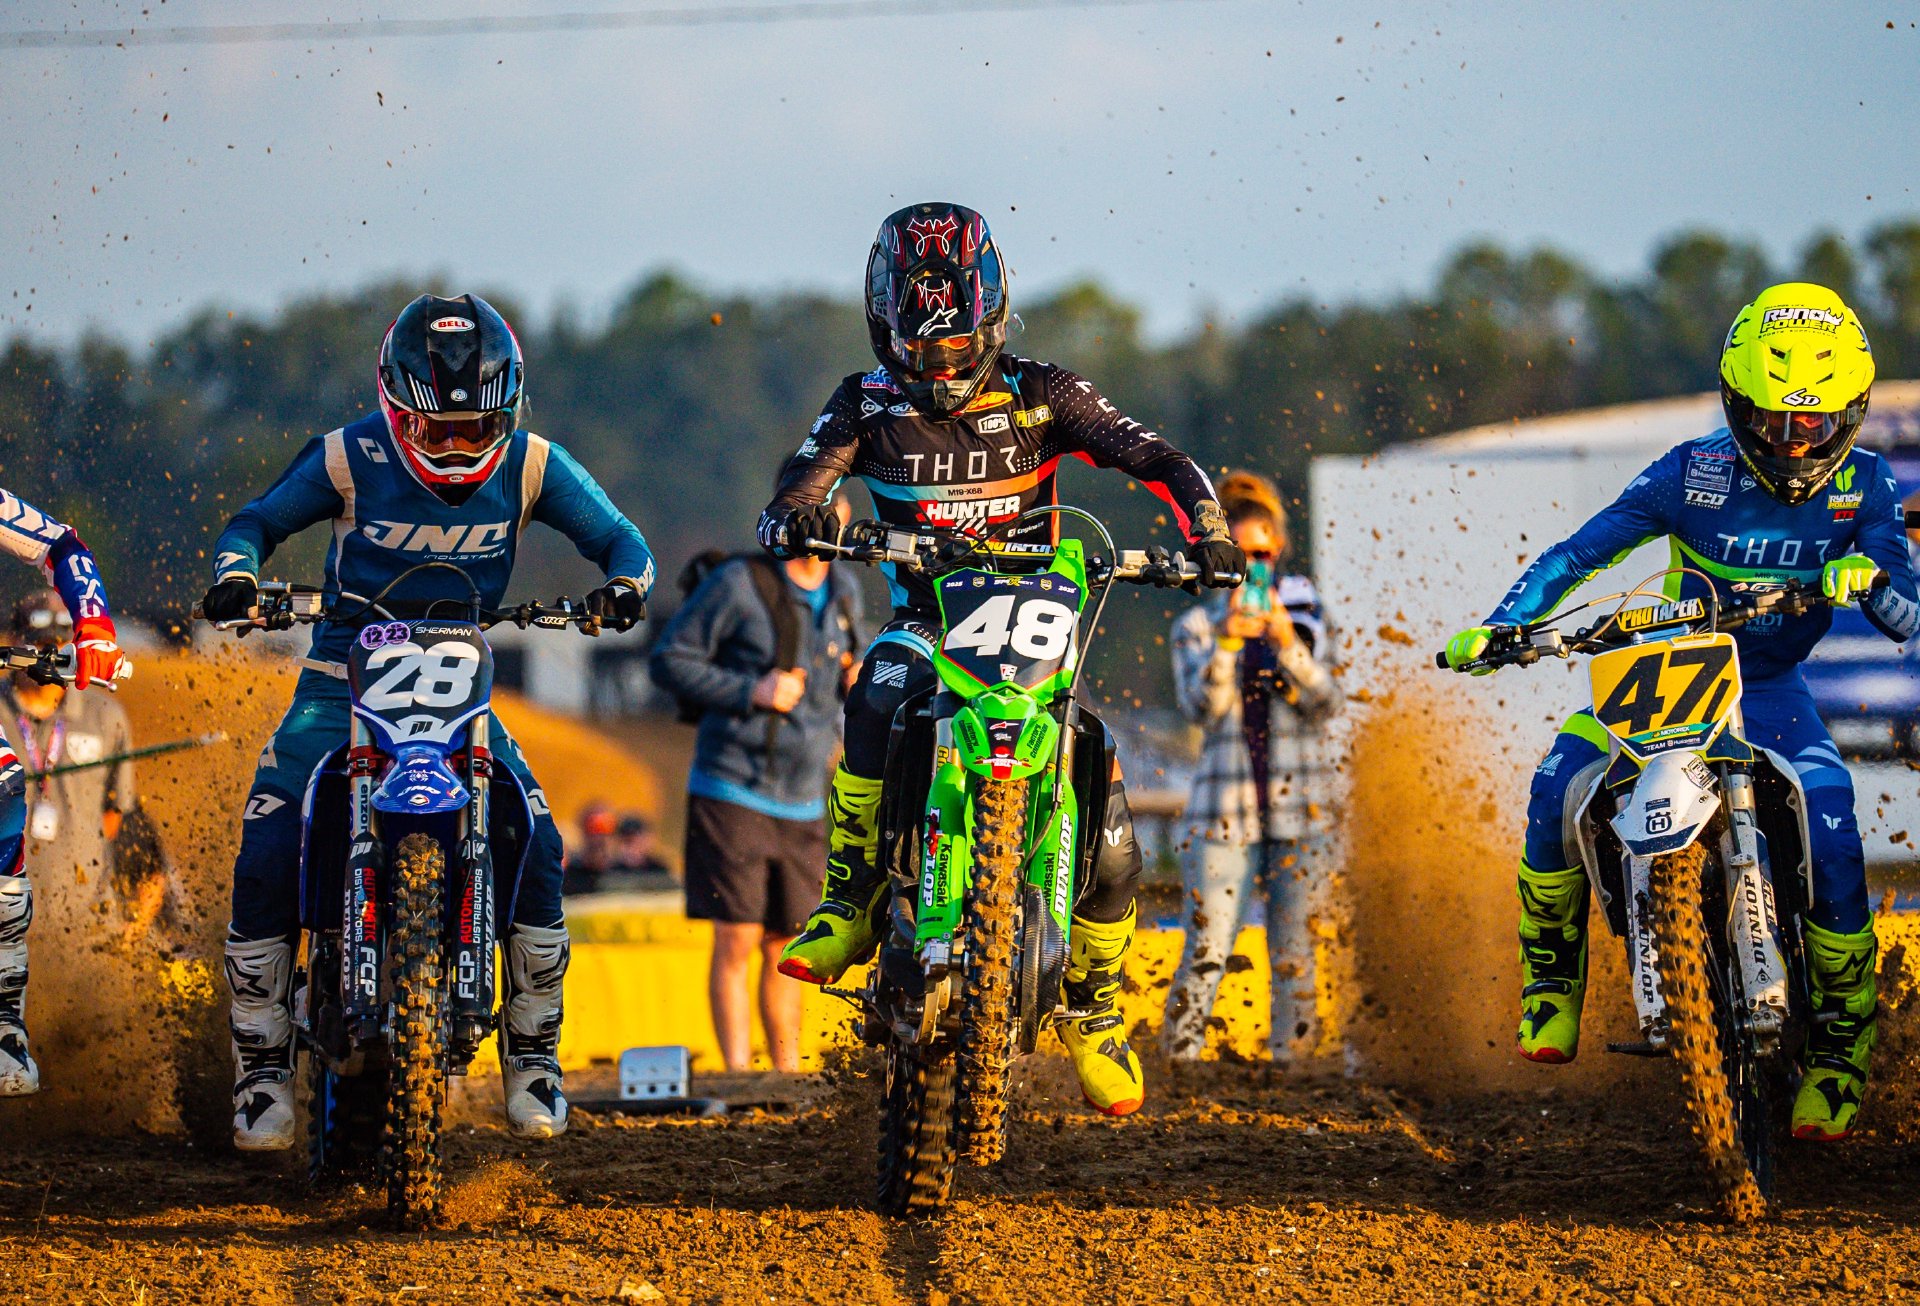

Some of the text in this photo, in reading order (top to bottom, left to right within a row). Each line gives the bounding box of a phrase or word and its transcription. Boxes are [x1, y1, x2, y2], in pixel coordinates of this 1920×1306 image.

[437, 320, 469, 328] BELL
[1761, 318, 1837, 334] POWER
[982, 416, 1006, 431] 100%
[1695, 462, 1723, 473] TEAM
[925, 495, 1021, 521] HUNTER
[415, 626, 473, 637] SHERMAN
[943, 595, 1074, 661] 48
[1622, 599, 1700, 628] PROTAPER
[364, 630, 382, 644] 12
[385, 627, 408, 640] 23
[359, 641, 480, 711] 28
[1643, 742, 1666, 751] TEAM
[936, 842, 953, 909] Kawasaki
[1042, 852, 1056, 908] awasaki
[1053, 813, 1074, 919] DUNLOP
[472, 868, 483, 944] DISTRIBUTORS
[1744, 873, 1766, 966] DUNLOP
[360, 946, 377, 997] FCP
[458, 950, 475, 999] FCP
[1637, 921, 1654, 1004] UNLOP
